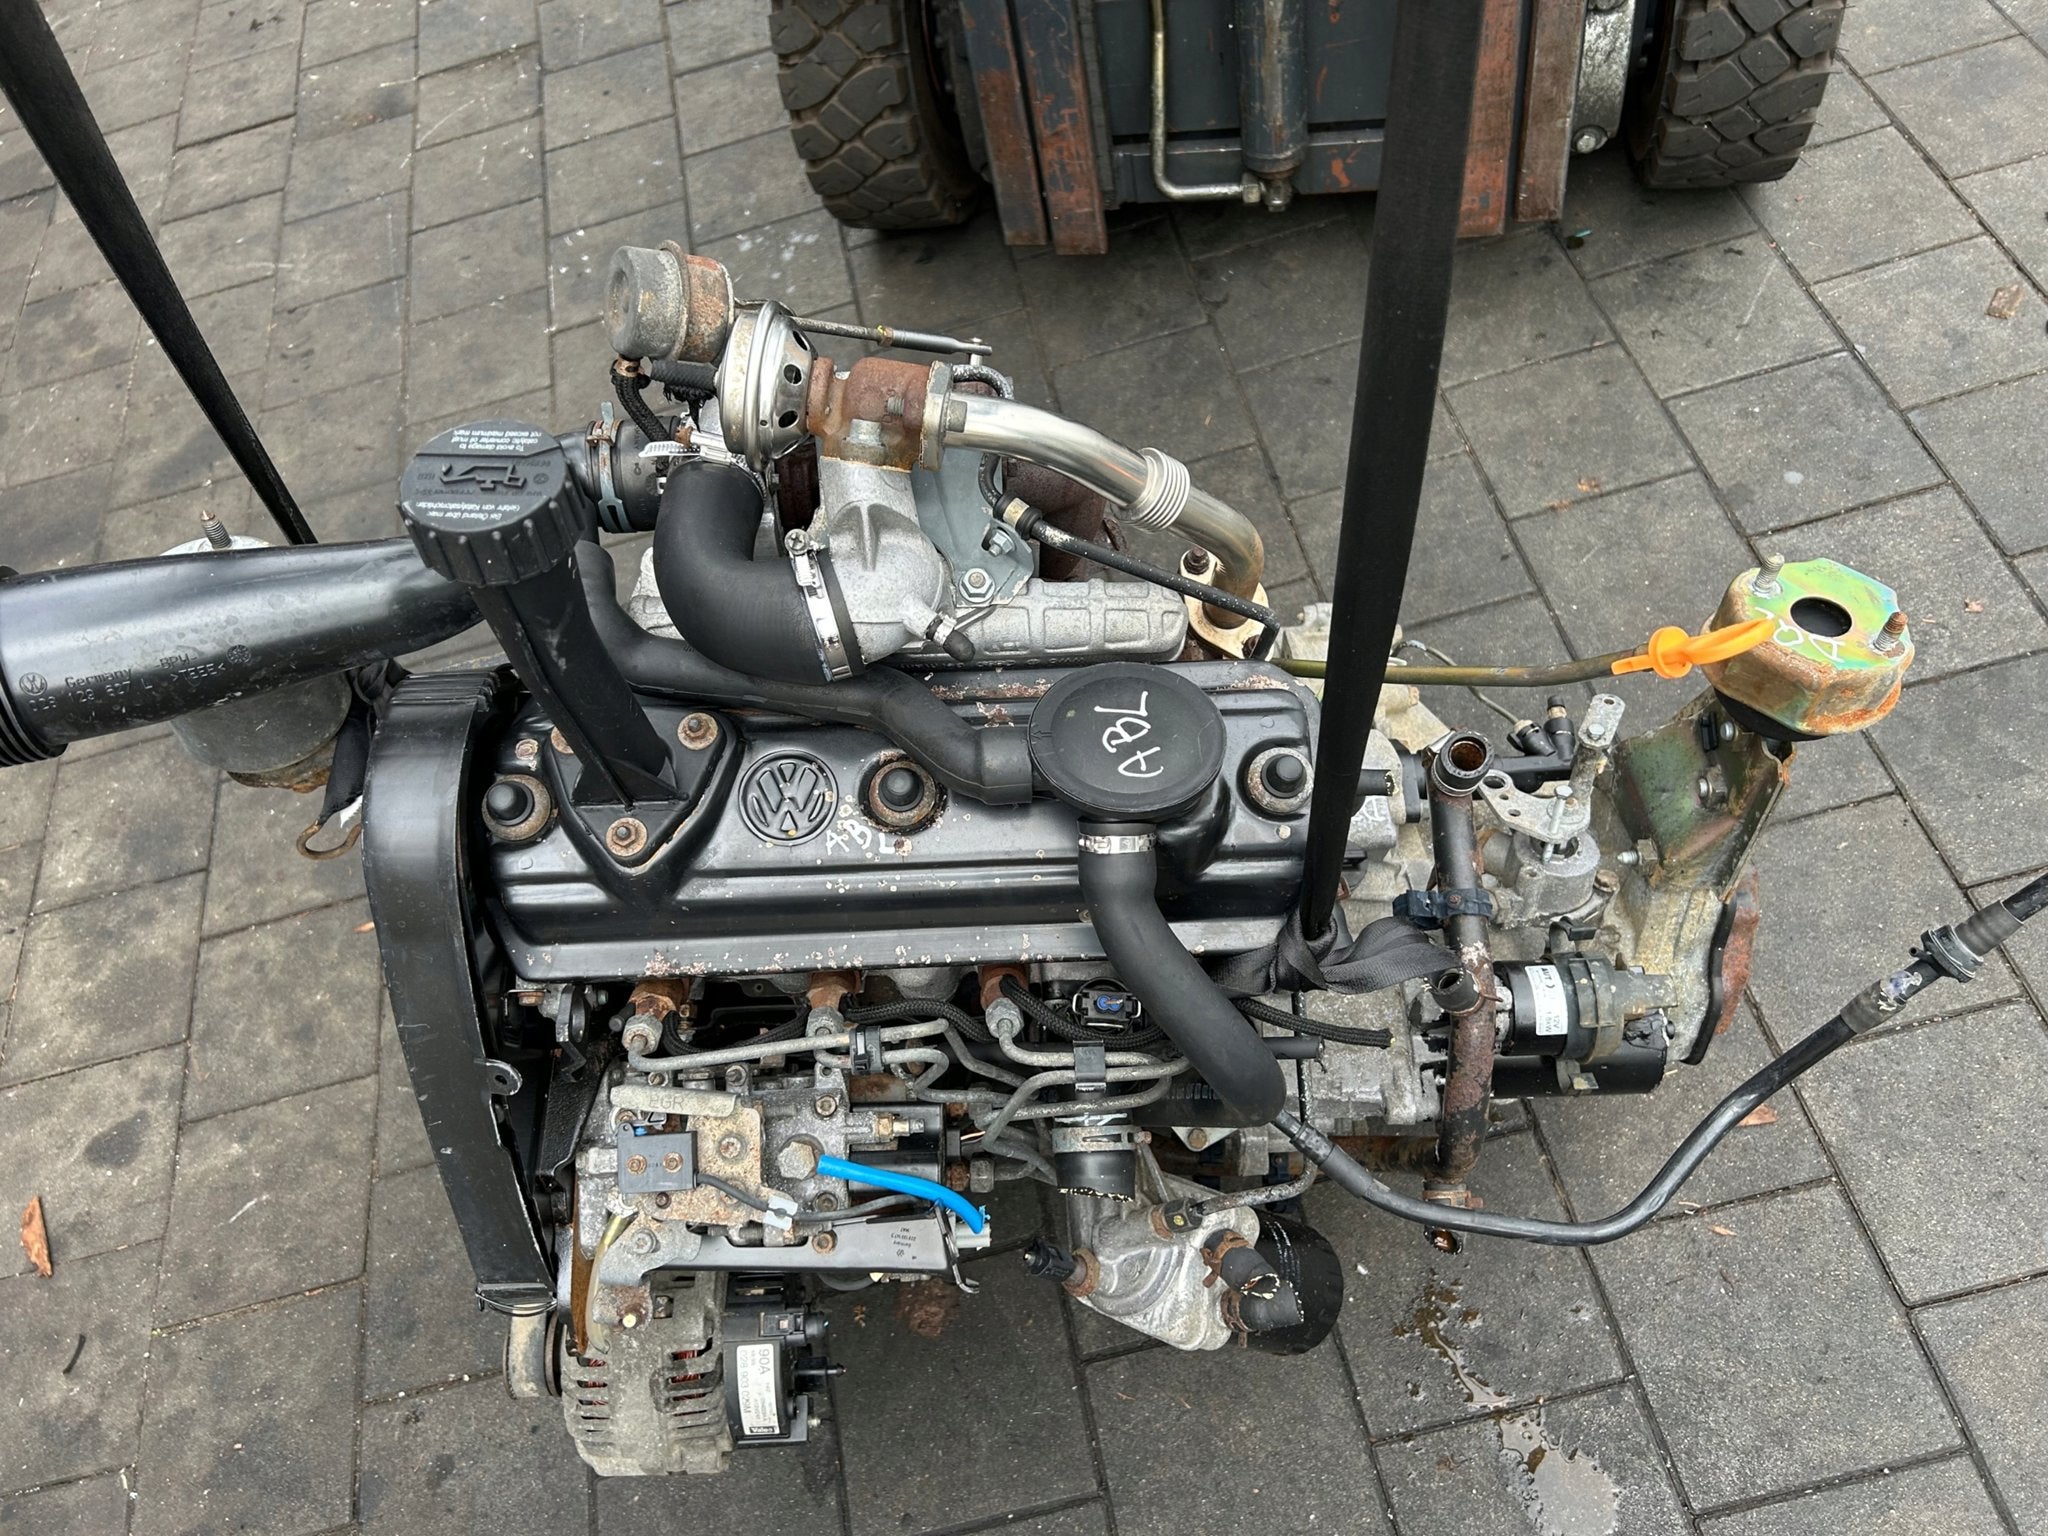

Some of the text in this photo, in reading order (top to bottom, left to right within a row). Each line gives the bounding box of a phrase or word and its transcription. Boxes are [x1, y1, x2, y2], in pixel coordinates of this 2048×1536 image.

[468, 442, 496, 450] damage
[479, 436, 510, 444] converter
[64, 667, 133, 689] Germany
[1094, 690, 1164, 778] ABL
[758, 1348, 771, 1375] 90A
